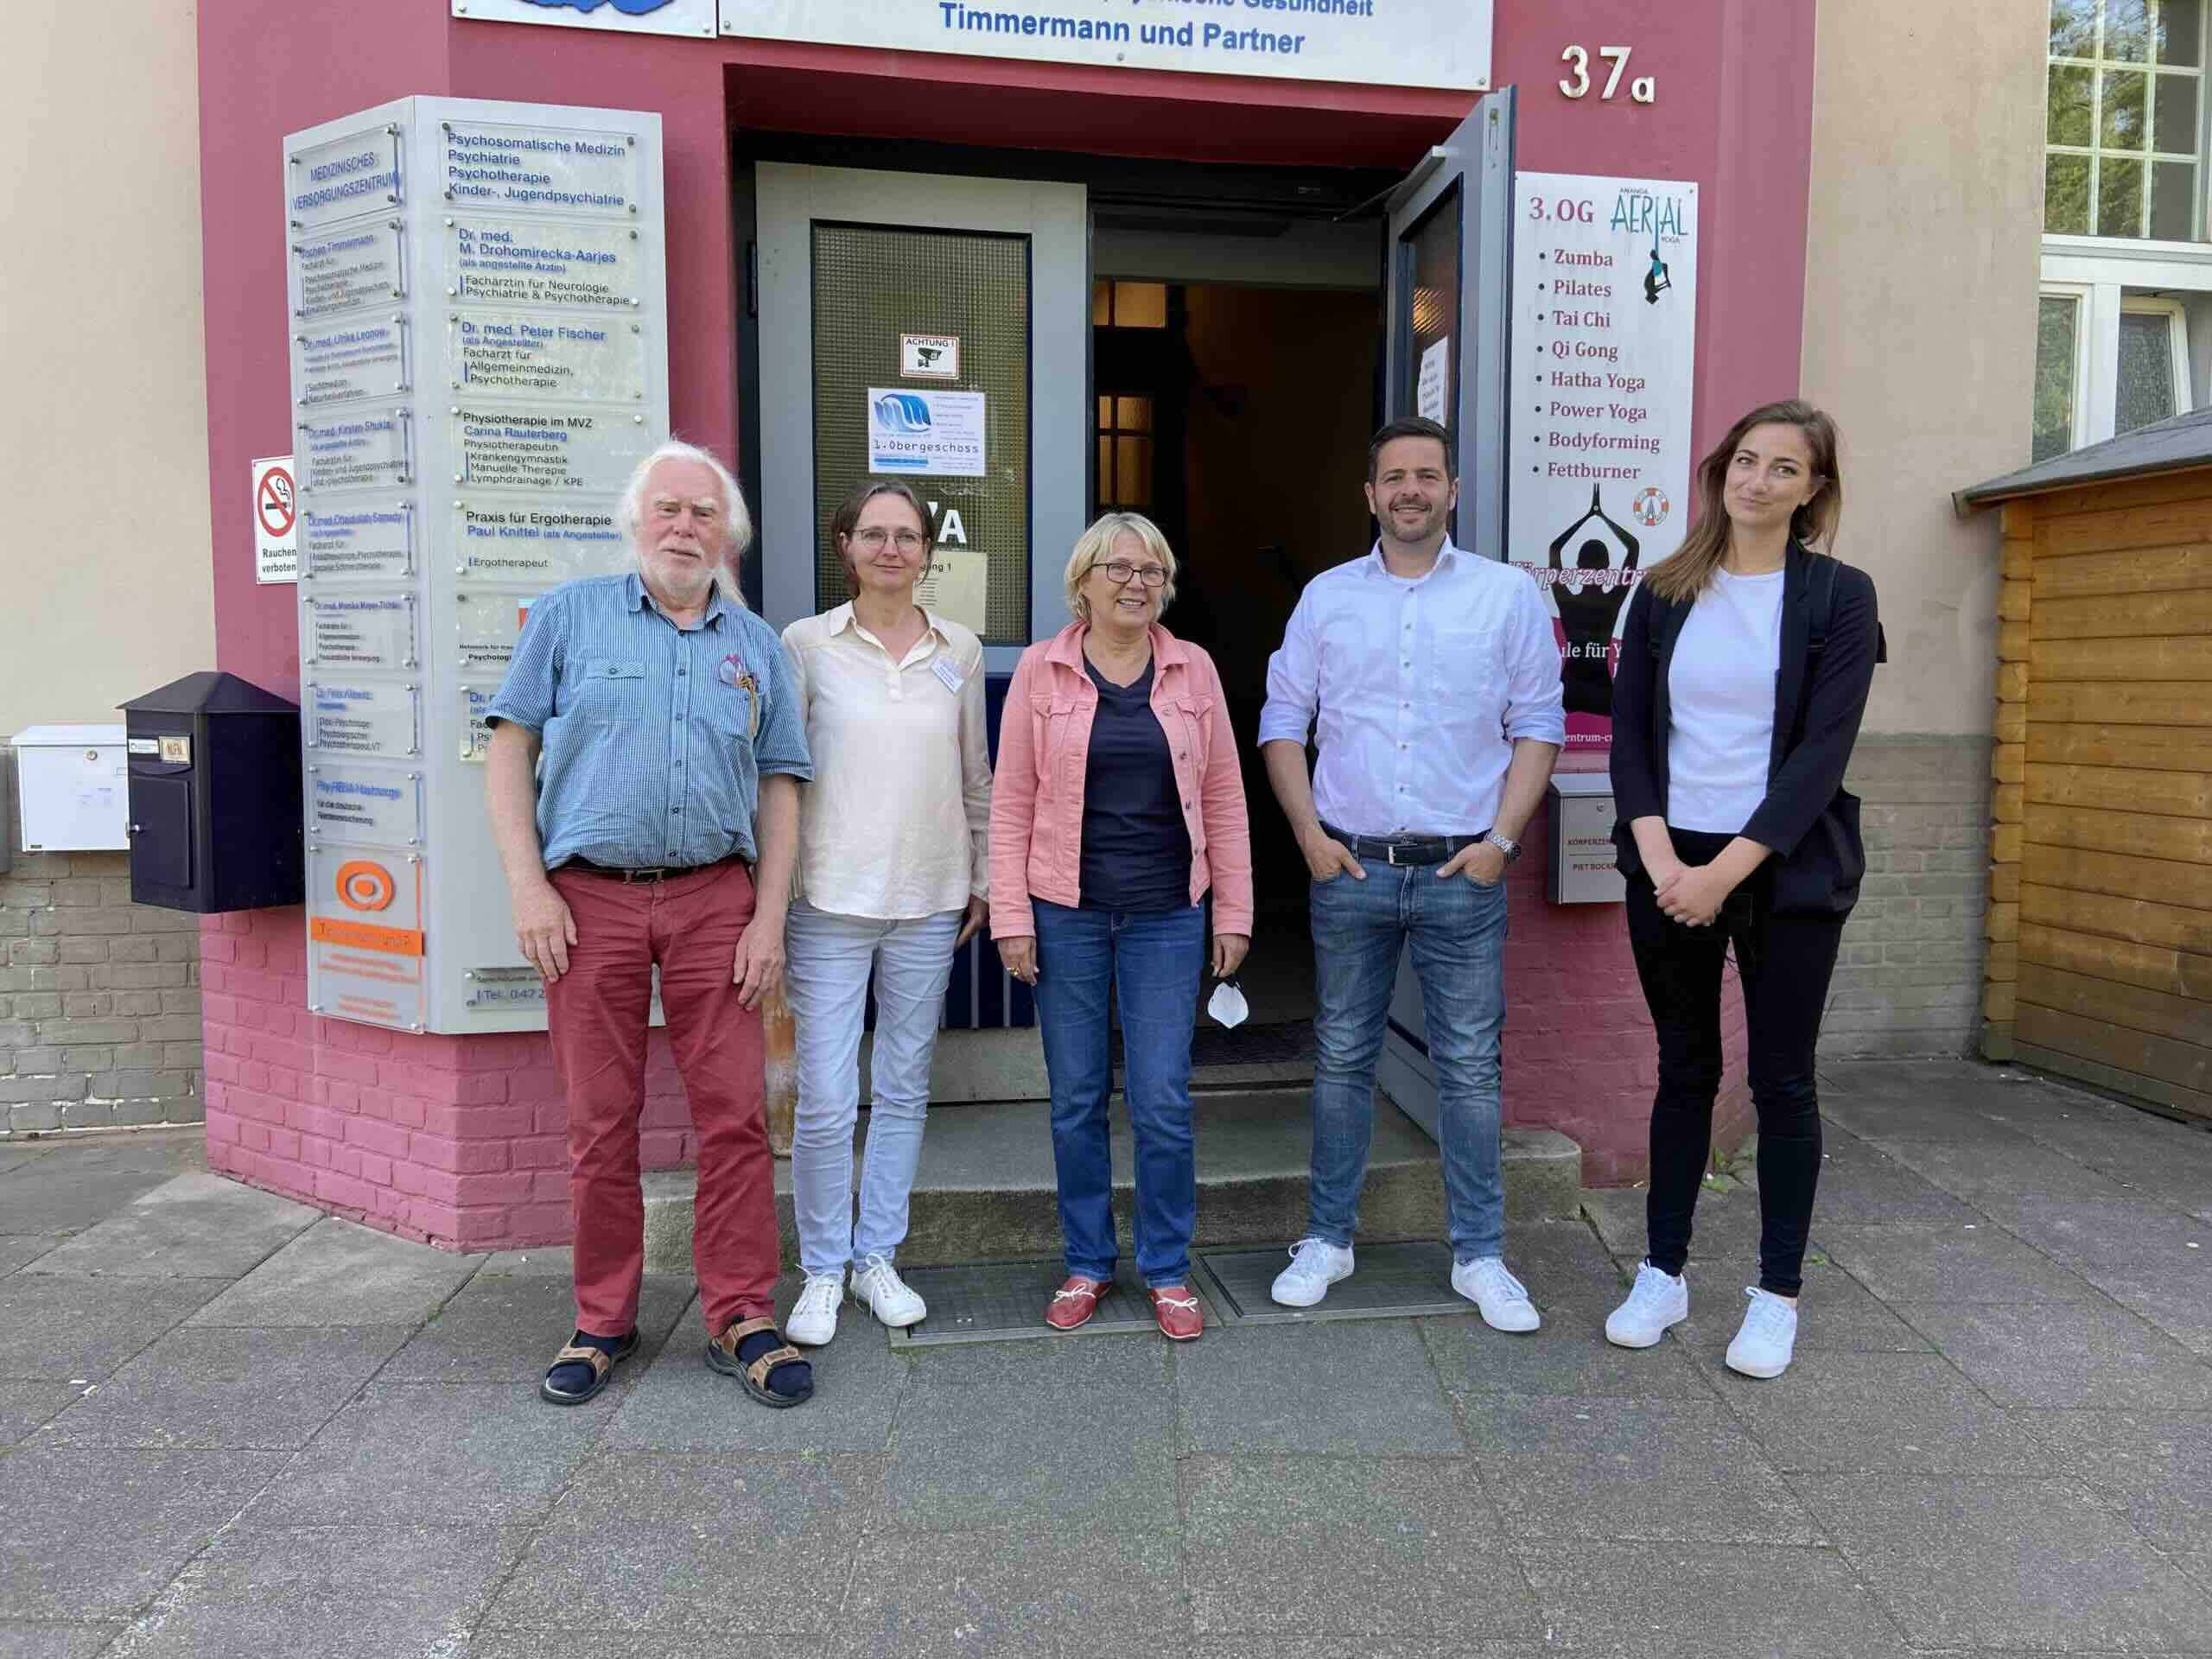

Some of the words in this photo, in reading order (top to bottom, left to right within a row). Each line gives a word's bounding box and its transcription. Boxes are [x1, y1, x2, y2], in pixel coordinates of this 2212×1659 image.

[1244, 0, 1373, 16] esundheit
[940, 2, 1129, 42] Timmermann
[1141, 22, 1192, 46] und
[1203, 22, 1306, 54] Partner
[1559, 45, 1655, 103] 37a
[448, 132, 572, 153] Psychosomatische
[575, 141, 626, 157] Medizin
[310, 150, 375, 182] MEDIZINISCHES
[448, 149, 520, 166] Psychiatrie
[448, 166, 551, 185] Psychotherapie
[291, 171, 401, 212] VERSORGUNGSZENTRUM
[505, 187, 625, 207] Jugendpsychiatrie
[1610, 194, 1689, 236] AERIAL
[459, 227, 475, 241] Dr.
[480, 231, 512, 243] med.
[459, 243, 474, 255] M.
[1554, 249, 1613, 267] Zumba
[466, 285, 528, 300] Psychiatrie
[532, 289, 541, 299] &
[544, 289, 630, 306] Psychotherapie
[549, 280, 609, 295] Neurologie
[1554, 279, 1612, 297] Pilates
[1553, 310, 1579, 327] Tai
[1584, 311, 1611, 327] Chi
[462, 321, 477, 333] Dr.
[520, 325, 553, 338] Peter
[558, 327, 606, 341] Fischer
[905, 338, 949, 347] ACHTUNG
[463, 346, 511, 359] Facharzt
[1552, 340, 1570, 359] Qi
[1575, 341, 1618, 363] Gong
[470, 361, 575, 378] Allgemeinmedizin,
[470, 373, 558, 388] Psychotherapie
[1551, 372, 1602, 388] Hatha
[1606, 372, 1646, 393] Yoga
[463, 412, 547, 427] Physiotherapie
[550, 416, 564, 427] im
[568, 417, 593, 428] MVZ
[1550, 401, 1604, 417] Power
[1608, 403, 1647, 423] Yoga
[1548, 431, 1661, 454] Bodyforming
[470, 453, 568, 465] Krankengymnastik
[470, 462, 518, 474] Manuelle
[522, 465, 567, 476] Therapie
[1548, 461, 1642, 480] Fettburner
[467, 511, 505, 524] Praxis
[509, 512, 526, 524] für
[531, 513, 612, 527] Ergotherapie
[467, 525, 495, 537] Paul
[499, 526, 539, 537] Knittel
[262, 548, 297, 558] Rauchen
[262, 563, 296, 573] verboten
[474, 556, 549, 569] Ergotherapeut
[1508, 561, 1647, 591] rperzentr
[1585, 641, 1610, 658] für
